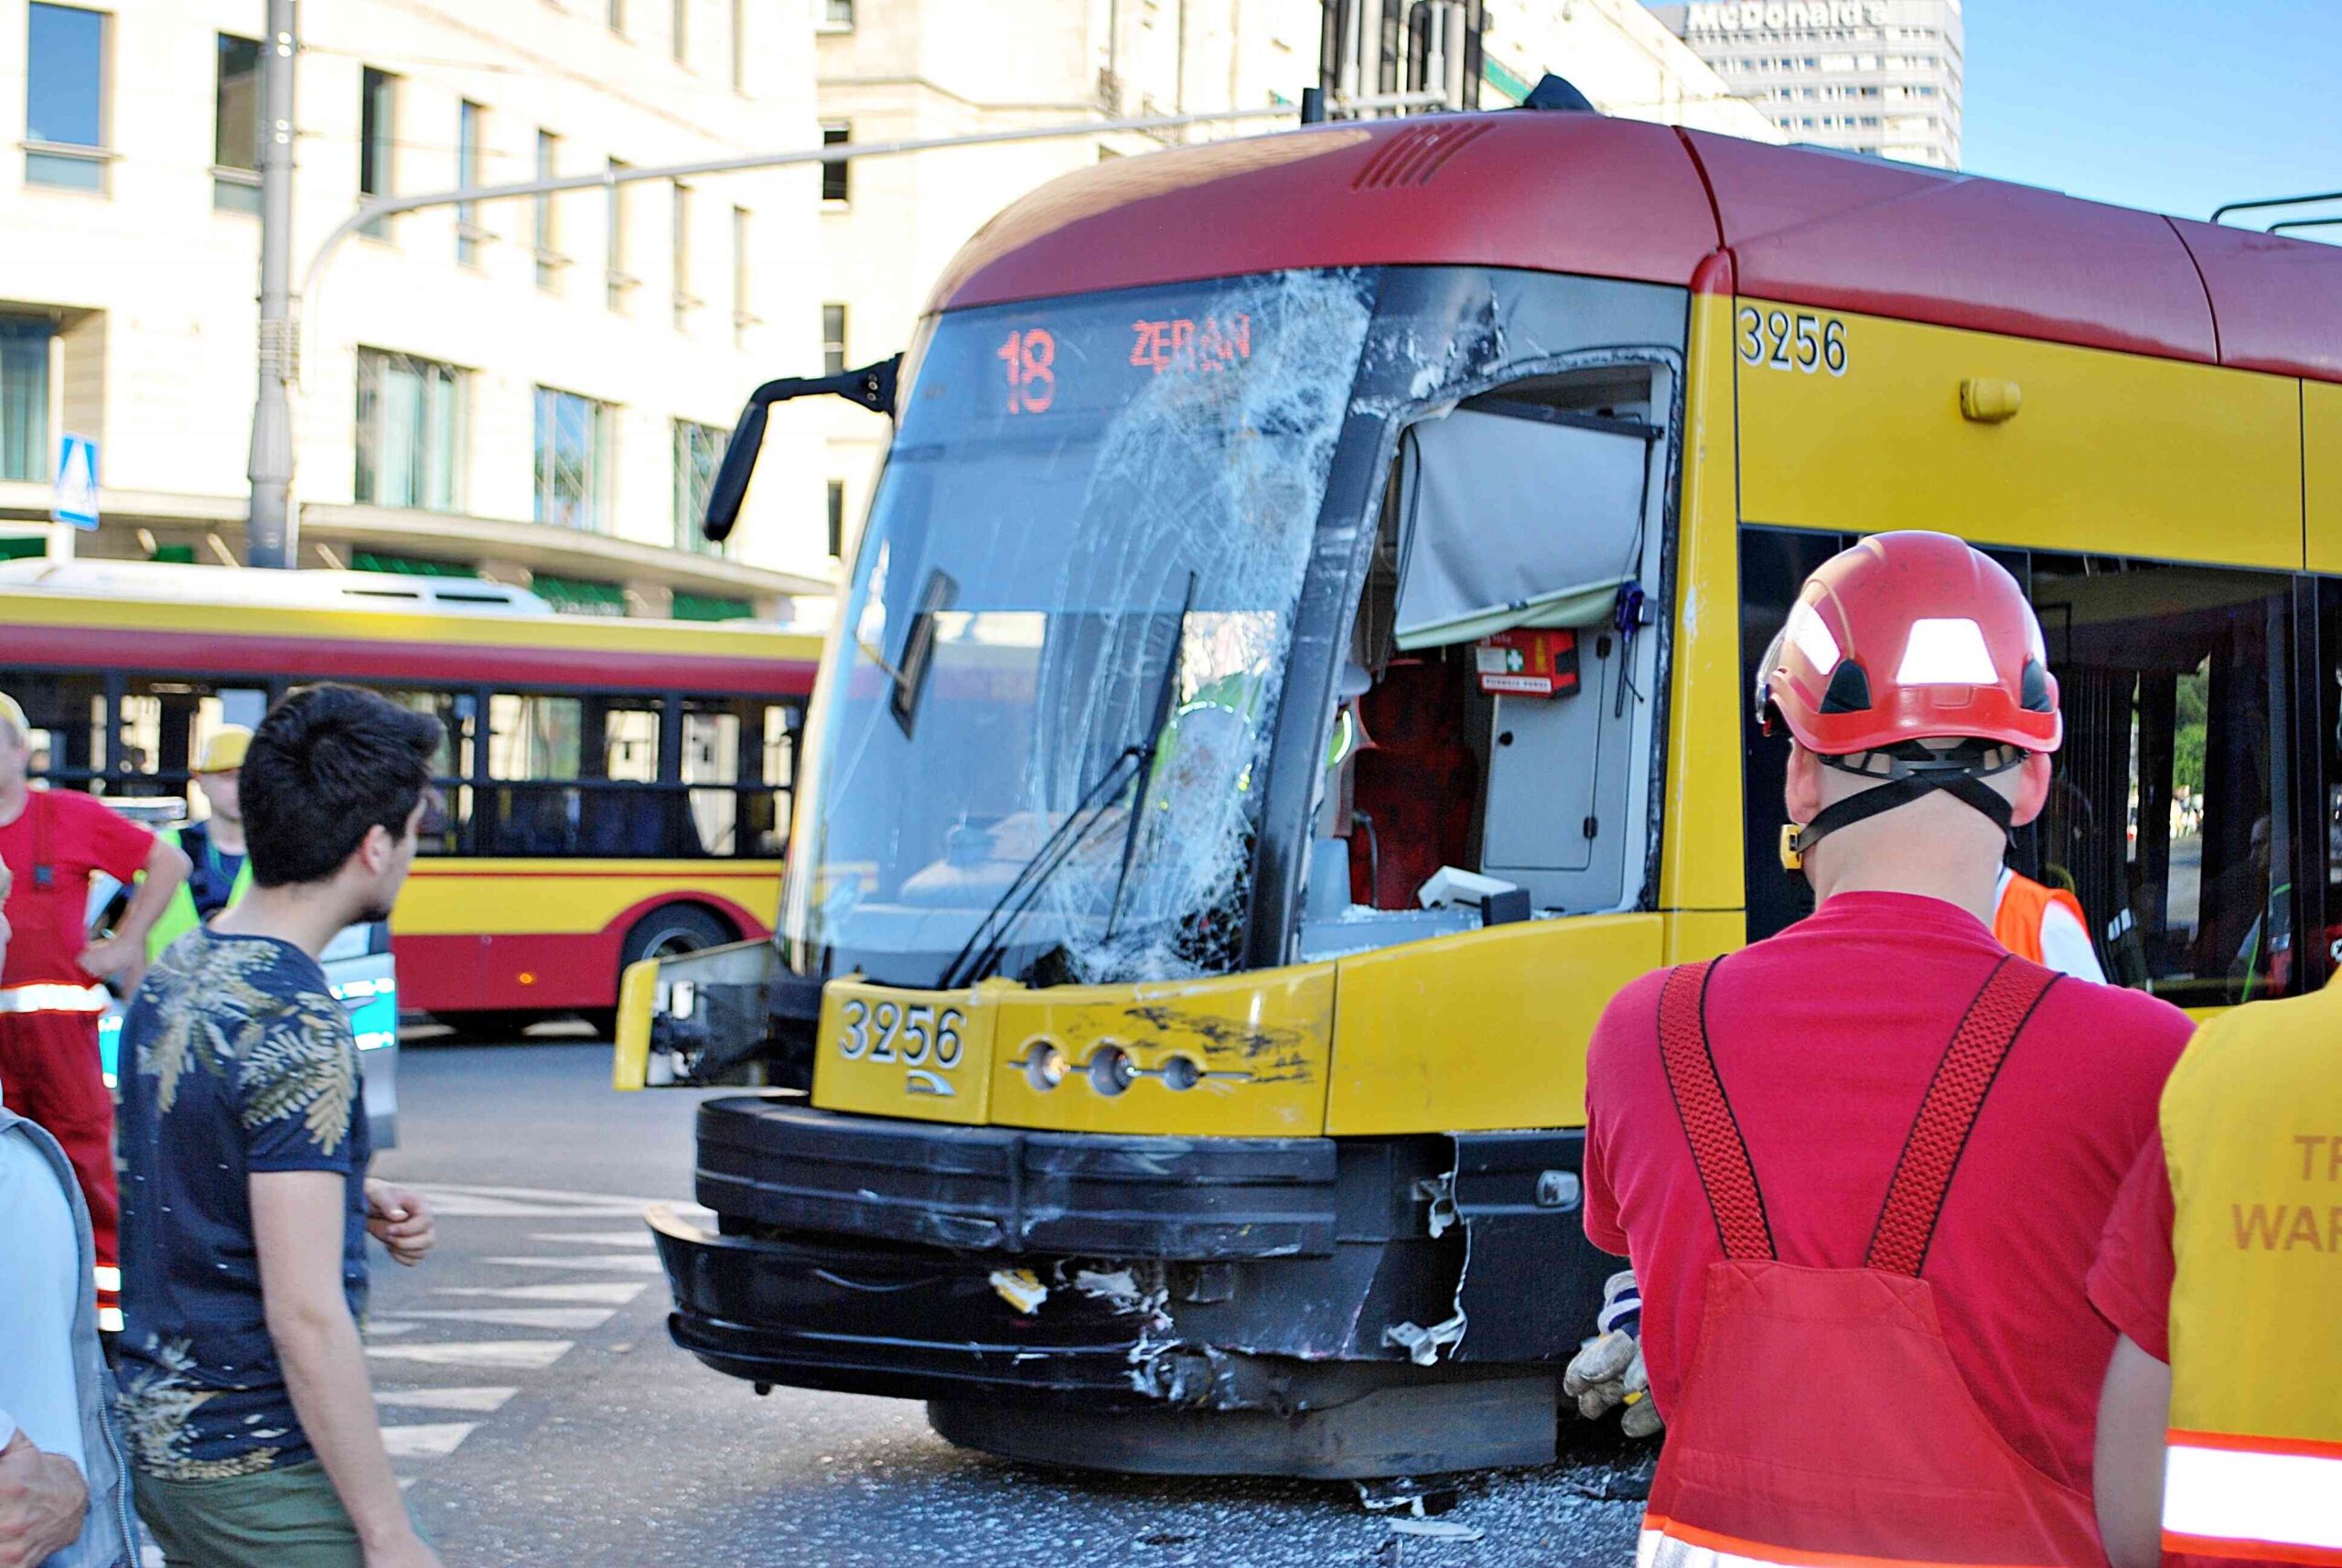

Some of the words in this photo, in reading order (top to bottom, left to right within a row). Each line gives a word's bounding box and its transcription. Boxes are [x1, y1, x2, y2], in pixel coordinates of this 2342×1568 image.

[1685, 1, 1889, 30] McDonald's
[997, 328, 1055, 413] 18
[1738, 306, 1847, 378] 3256
[840, 999, 967, 1069] 3256
